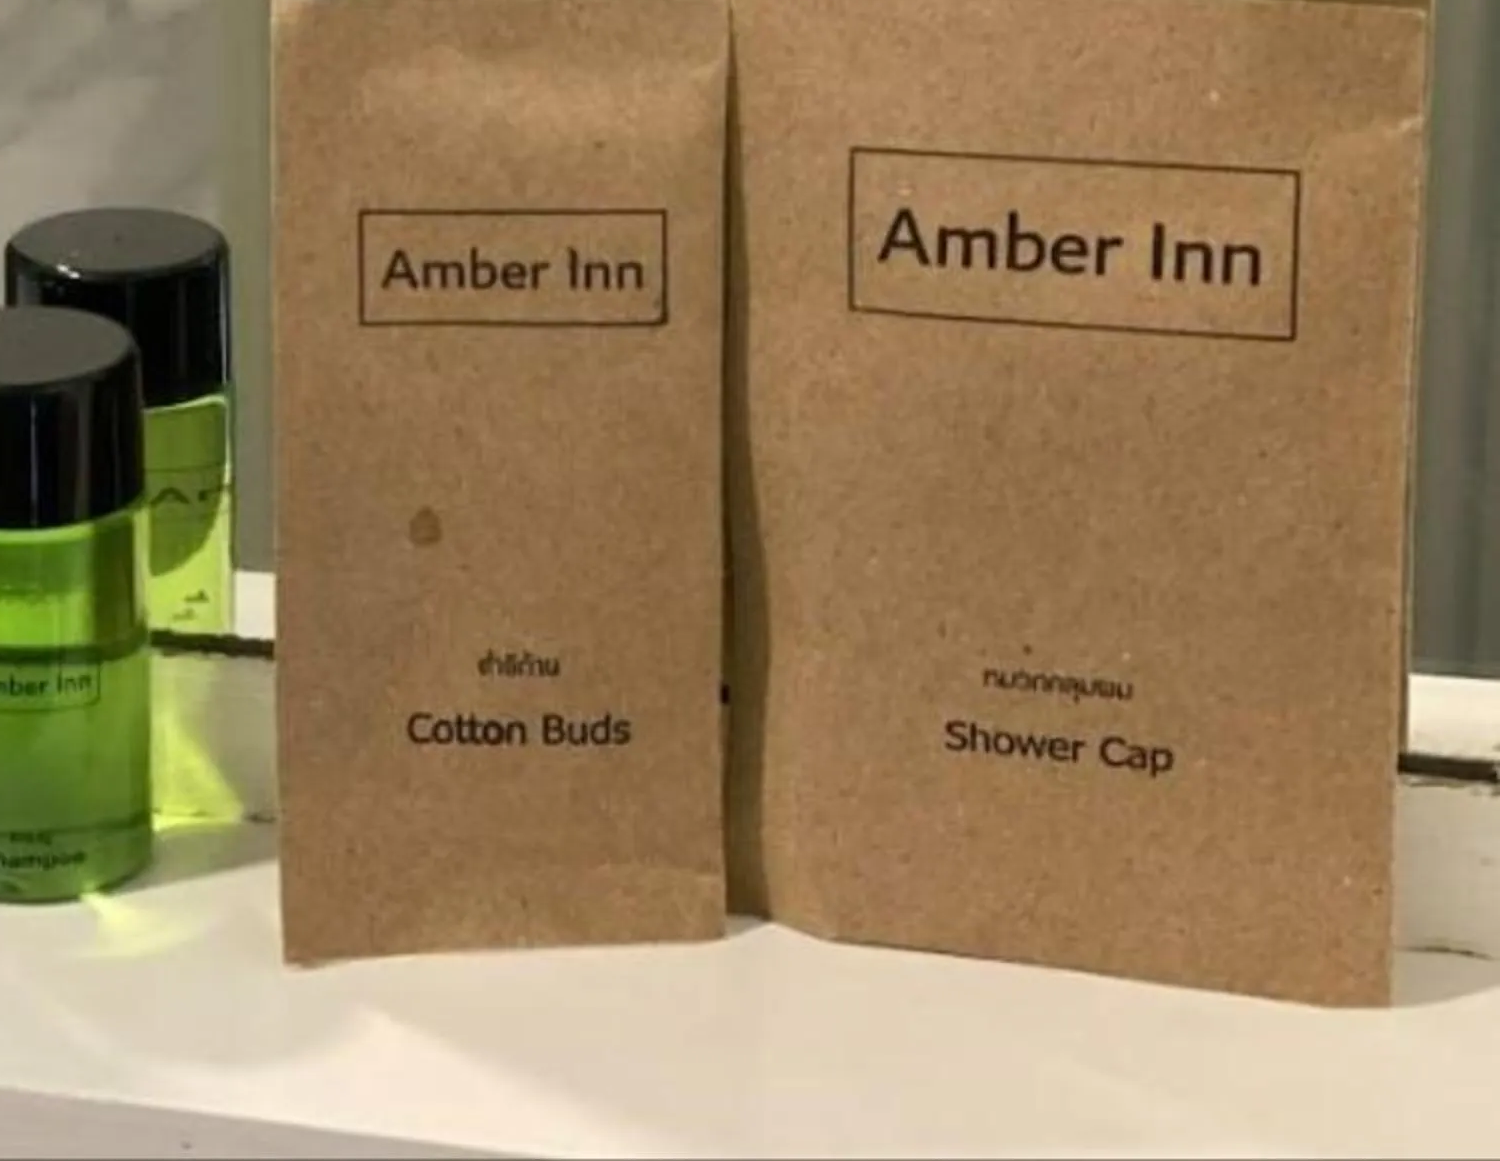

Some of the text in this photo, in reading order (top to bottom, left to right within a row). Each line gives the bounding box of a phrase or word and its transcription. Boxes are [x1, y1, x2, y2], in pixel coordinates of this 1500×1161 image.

[381, 245, 645, 291] Amber Inn
[877, 207, 1262, 287] Amber Inn
[56, 671, 92, 695] Inn
[407, 711, 633, 747] Cotton Buds
[944, 720, 1175, 779] Shower Cap
